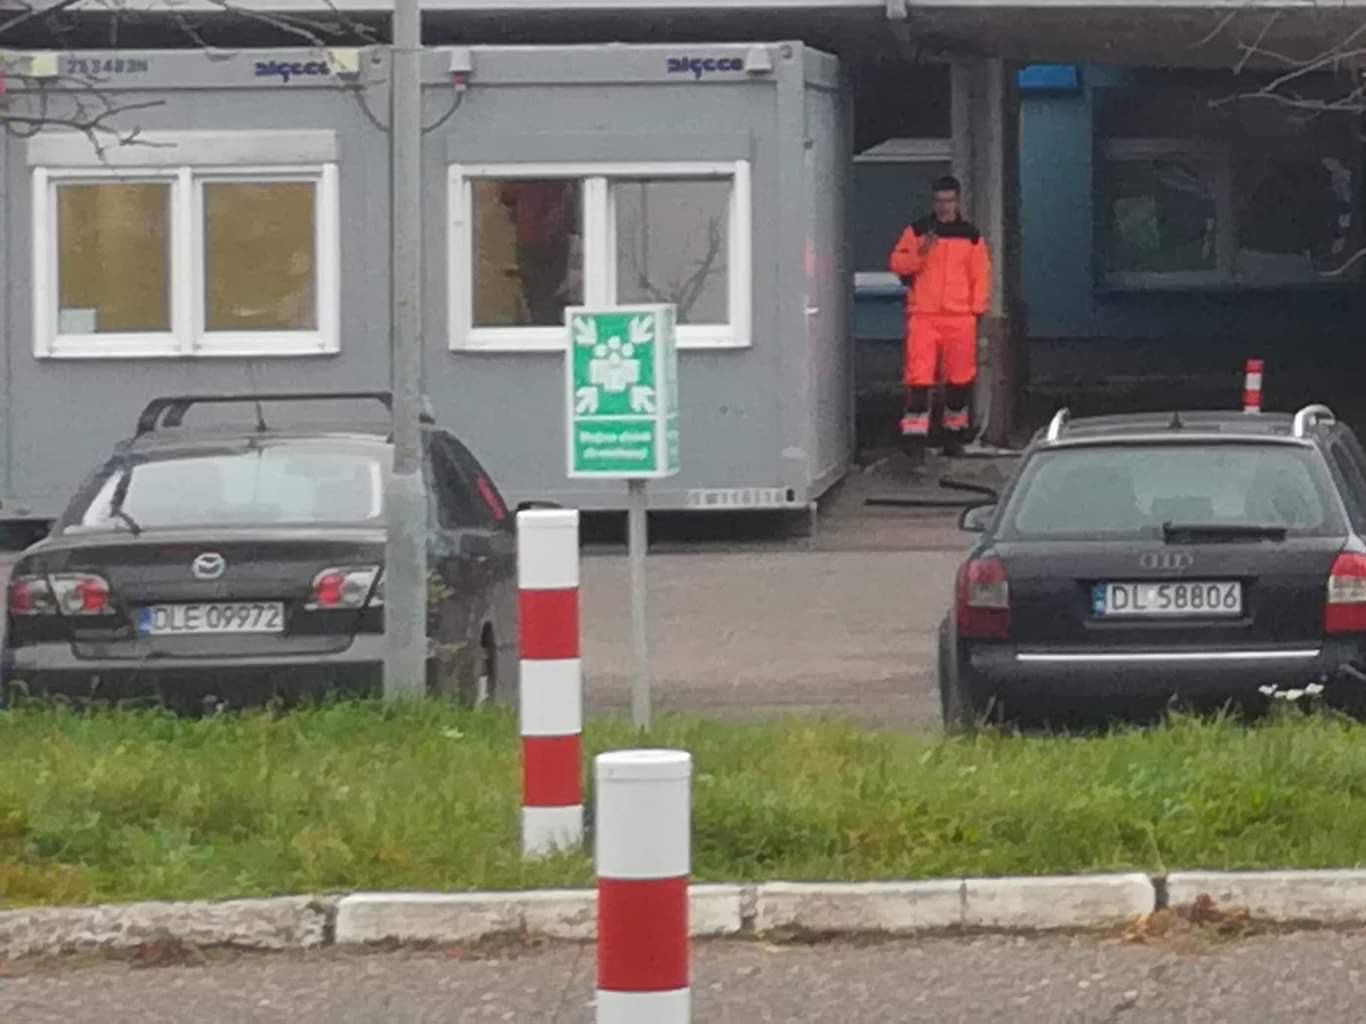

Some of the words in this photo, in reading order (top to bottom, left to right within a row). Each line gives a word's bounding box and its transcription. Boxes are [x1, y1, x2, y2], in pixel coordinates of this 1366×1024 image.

[1112, 584, 1147, 610] DL
[1157, 583, 1237, 609] 58806
[154, 607, 199, 631] DLE
[207, 605, 279, 629] 09972
